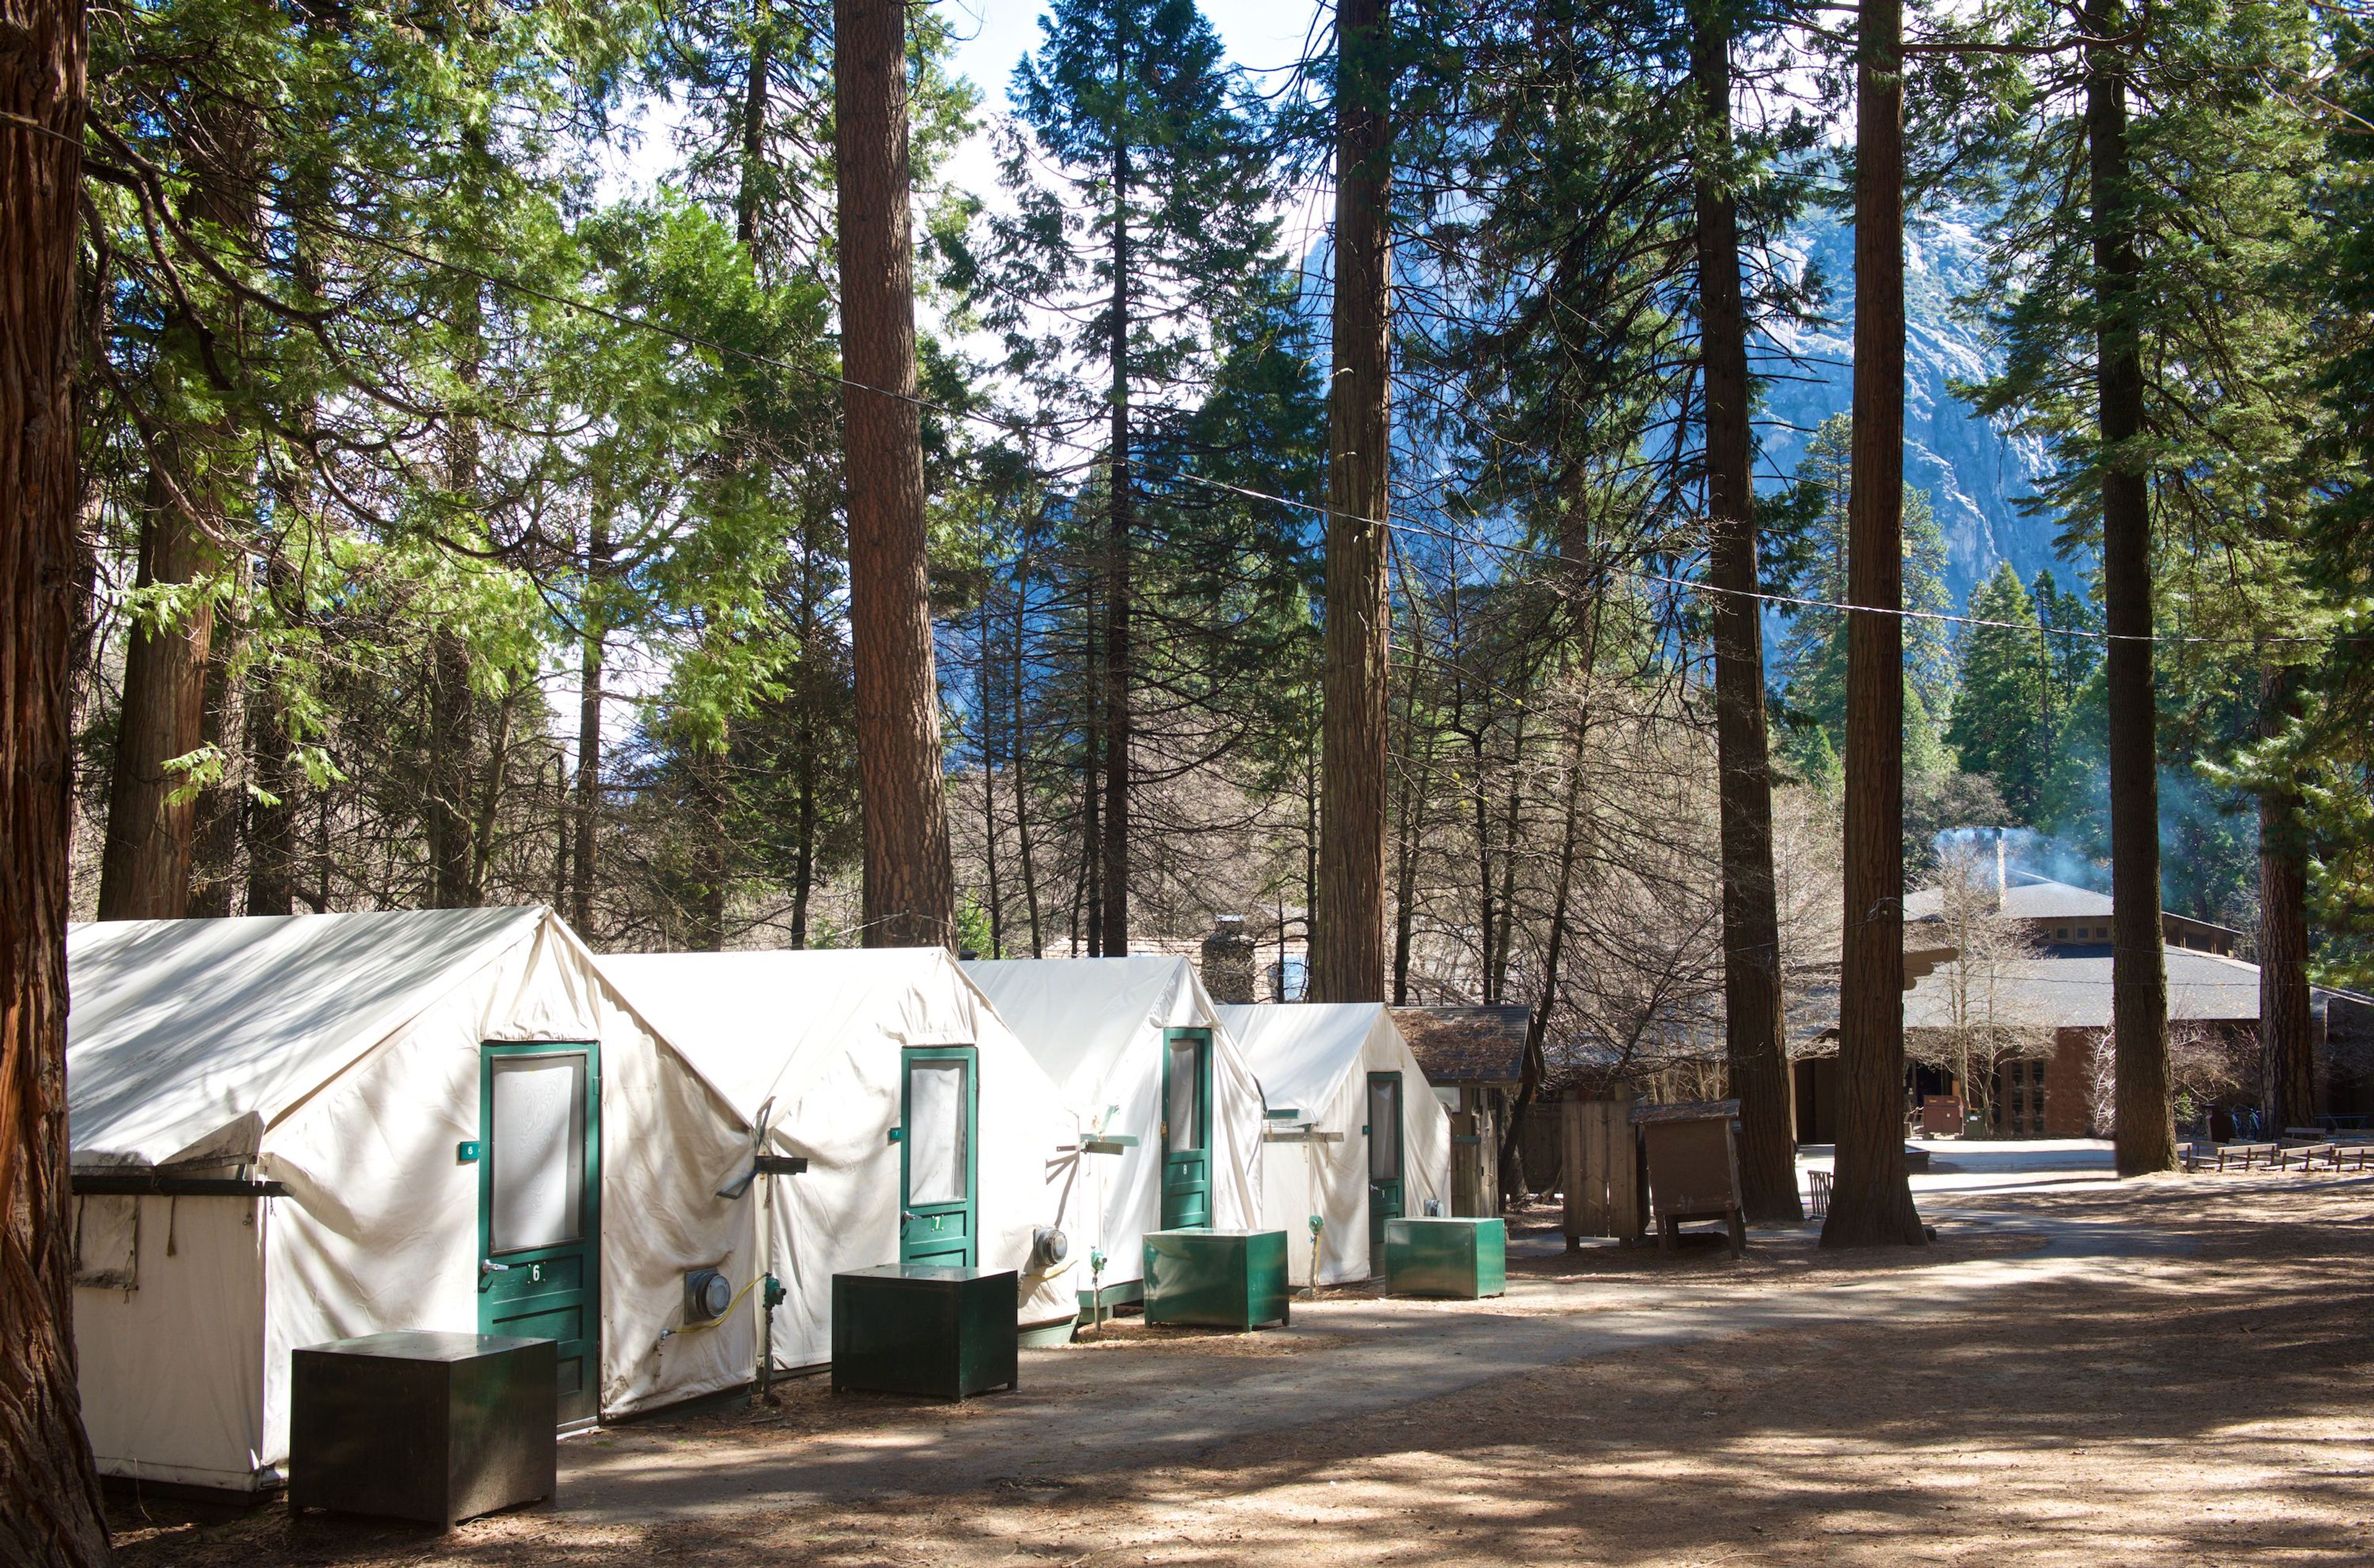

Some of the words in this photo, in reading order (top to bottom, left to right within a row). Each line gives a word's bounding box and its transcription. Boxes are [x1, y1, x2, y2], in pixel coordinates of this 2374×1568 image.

[468, 1146, 473, 1155] 6
[1183, 1164, 1187, 1174] 8
[935, 1216, 940, 1229] 7
[533, 1264, 540, 1281] 6
